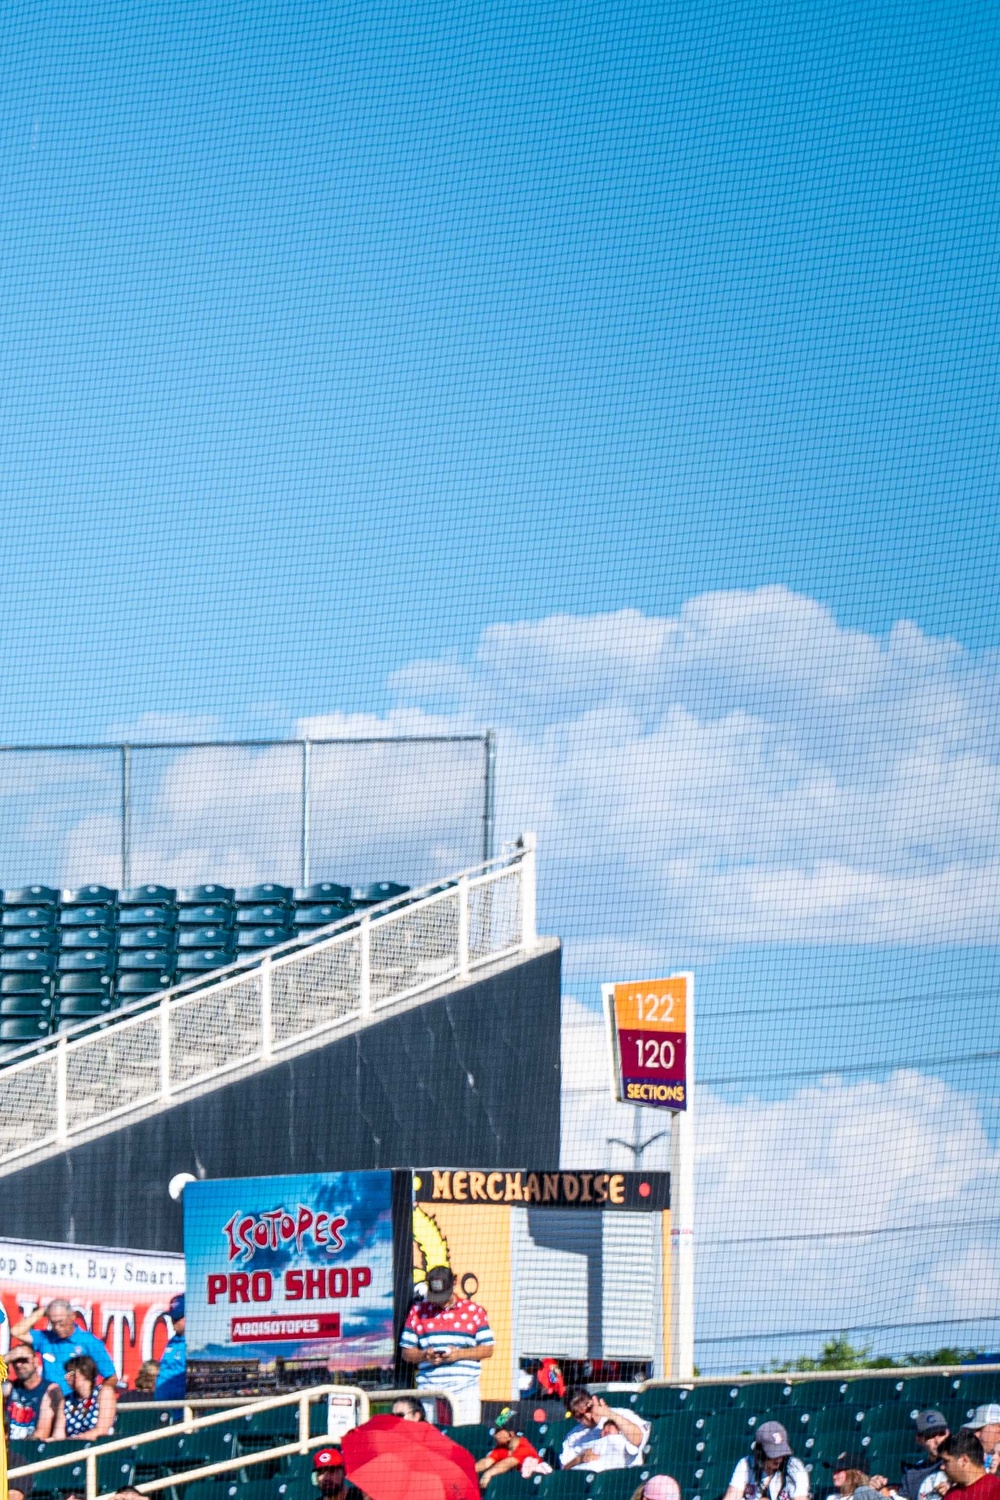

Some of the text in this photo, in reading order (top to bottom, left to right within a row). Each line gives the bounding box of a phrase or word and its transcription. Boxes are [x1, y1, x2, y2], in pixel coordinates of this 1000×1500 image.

[635, 993, 675, 1022] 122
[635, 1039, 675, 1069] 120
[627, 1083, 685, 1102] SECTIONS
[431, 1170, 625, 1204] MERCHANDISE
[222, 1203, 348, 1263] ISOTOPES
[24, 1254, 80, 1279] Smart,
[87, 1259, 116, 1284] Buy
[207, 1266, 372, 1305] PRO SHOP
